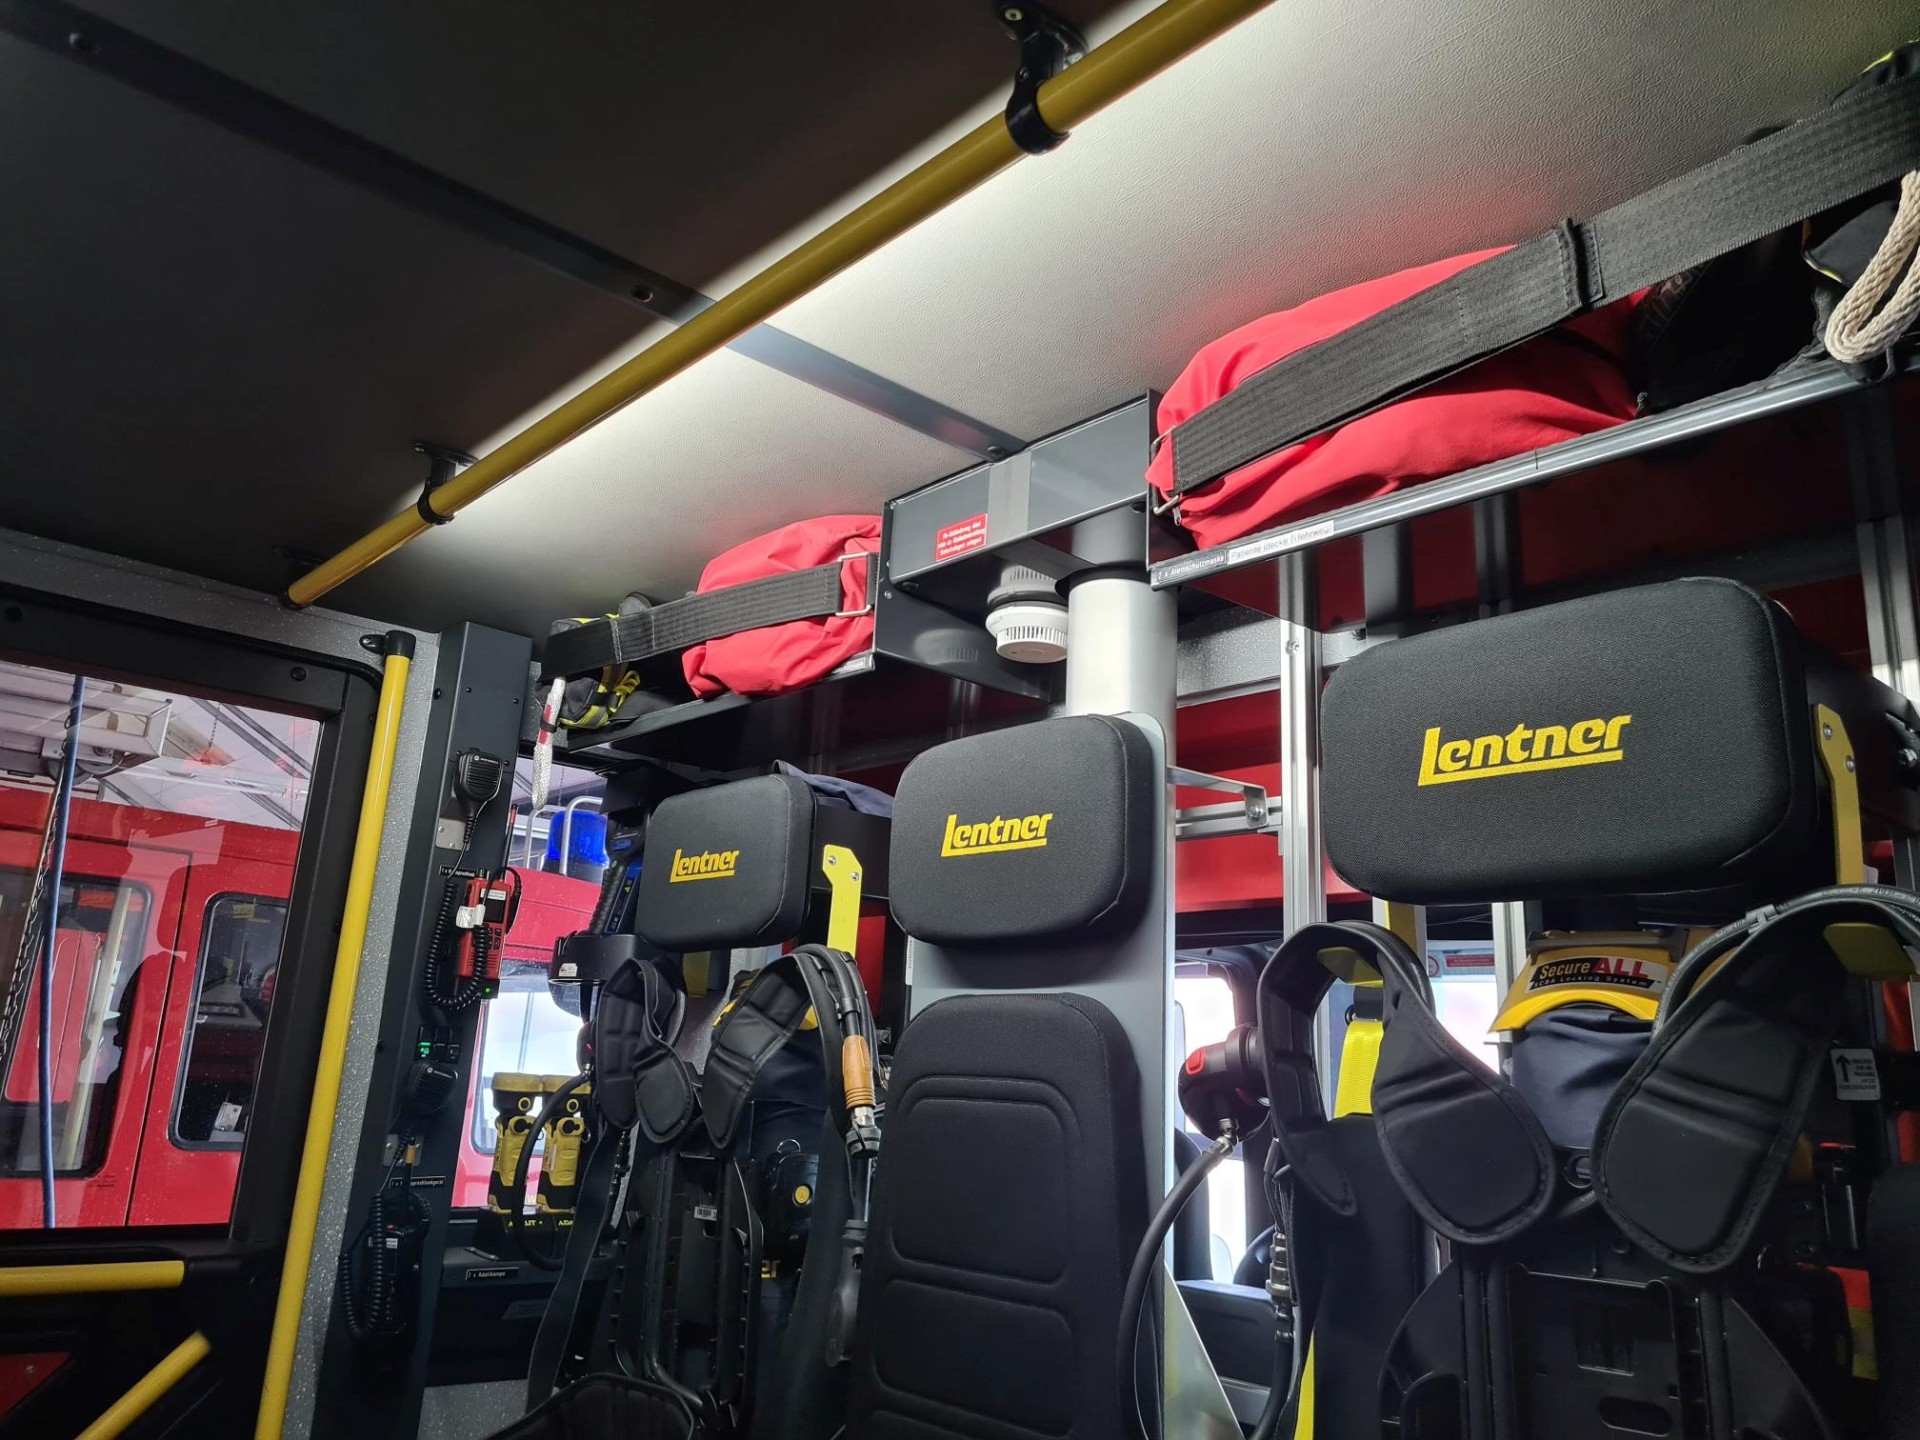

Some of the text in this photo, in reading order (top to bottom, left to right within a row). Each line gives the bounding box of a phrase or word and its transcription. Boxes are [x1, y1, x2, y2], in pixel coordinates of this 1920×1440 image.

[1418, 715, 1632, 786] Lentner
[941, 813, 1053, 857] Lentner
[670, 848, 740, 883] Lentner
[1533, 978, 1555, 988] SCBA
[1560, 975, 1600, 983] Locking
